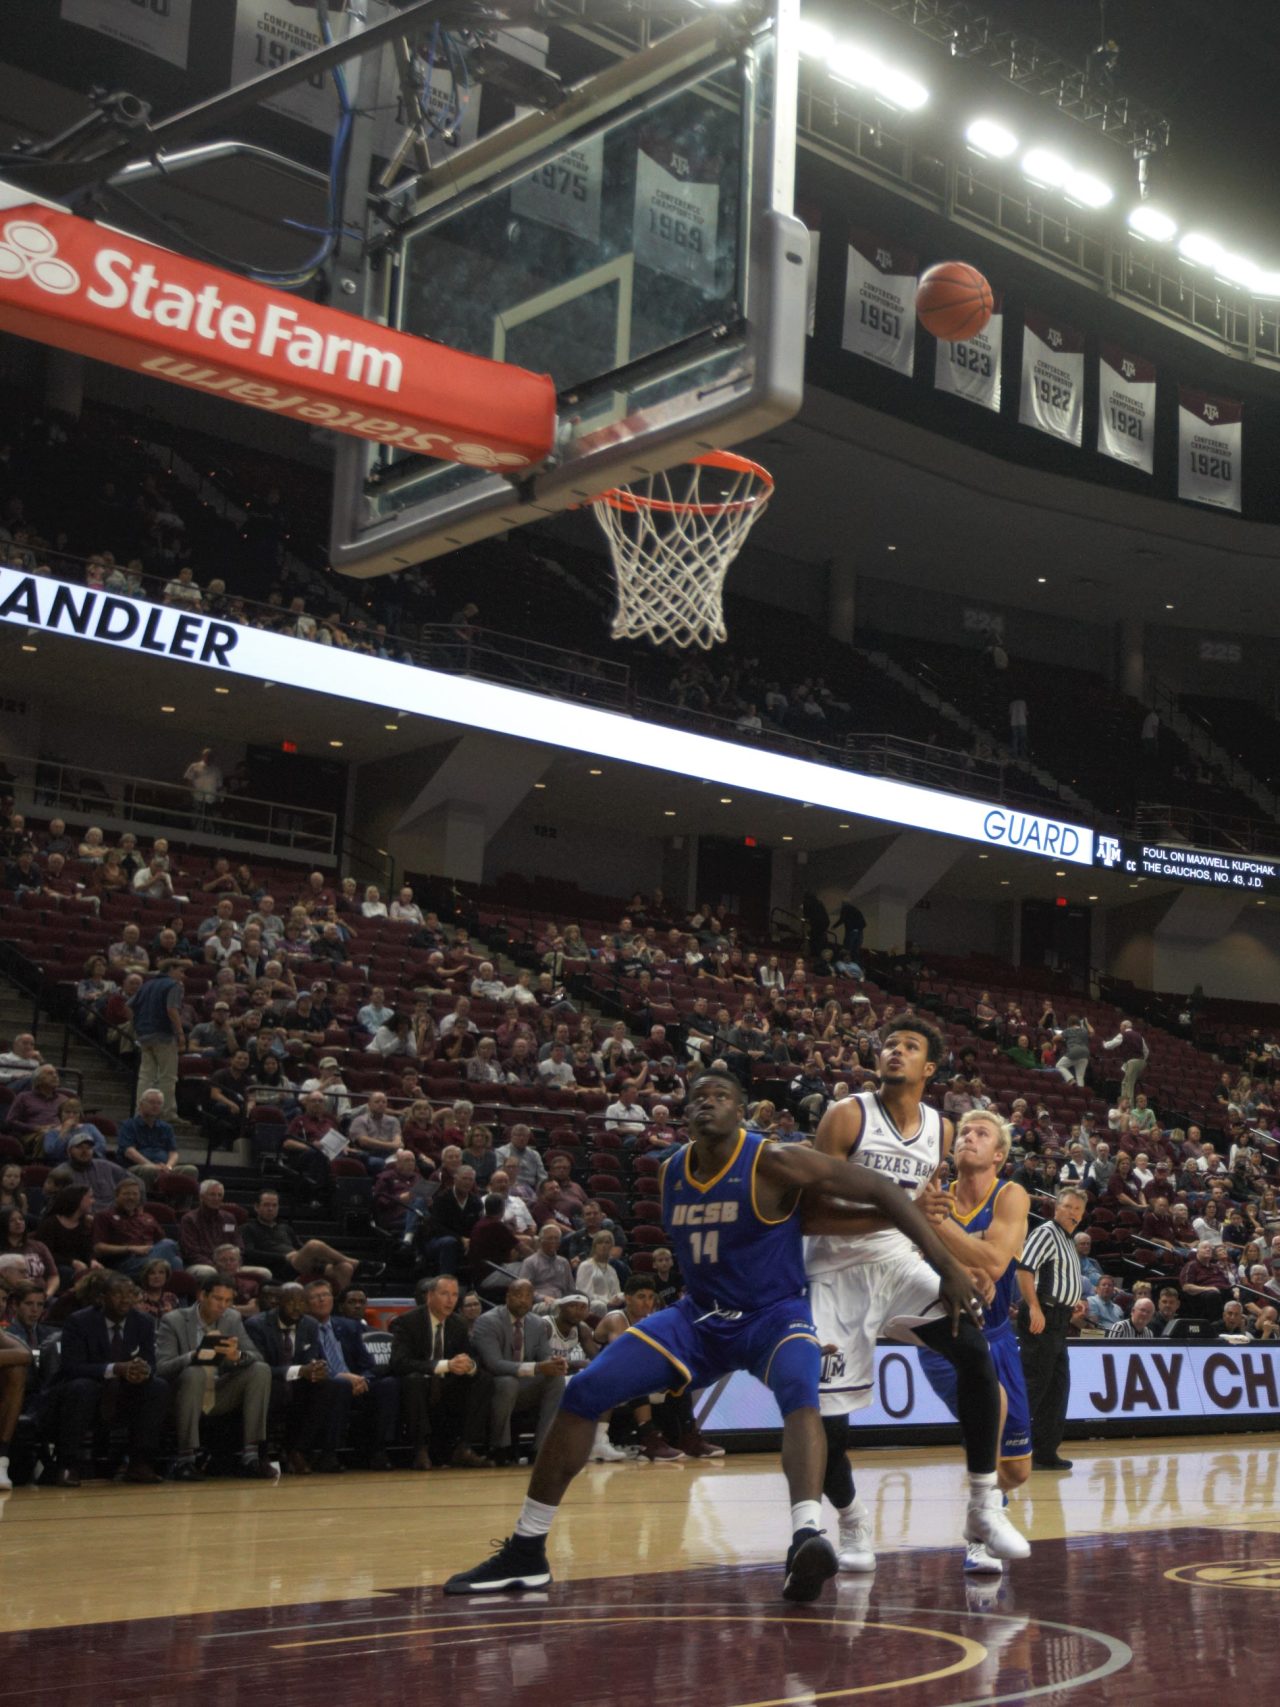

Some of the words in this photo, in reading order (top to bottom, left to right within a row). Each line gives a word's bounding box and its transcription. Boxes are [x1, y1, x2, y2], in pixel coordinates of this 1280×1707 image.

[650, 208, 703, 254] 1969
[860, 301, 900, 340] 1951
[950, 341, 991, 378] 1923
[1034, 375, 1072, 412] 1922
[1110, 407, 1144, 441] 1921
[1190, 441, 1232, 458] CHAMPIONSHIP
[1194, 435, 1229, 450] CONFERENCE
[1190, 452, 1232, 481] 1920
[983, 810, 1080, 857] GUARD
[1126, 860, 1137, 872] CC
[1143, 846, 1168, 861] FOUL
[1170, 851, 1185, 863] ON
[1187, 853, 1230, 870] MAXWELL
[1143, 861, 1161, 873] THE
[1163, 864, 1212, 882] GAUCHOS,
[1214, 871, 1230, 883] NO.
[1233, 874, 1246, 886] 43,
[1247, 877, 1264, 888] J.D.
[863, 1150, 911, 1176] TEXAS
[914, 1161, 937, 1178] A&M
[671, 1201, 739, 1226] UCSB
[690, 1230, 719, 1264] 14
[1089, 1353, 1184, 1414] JAY
